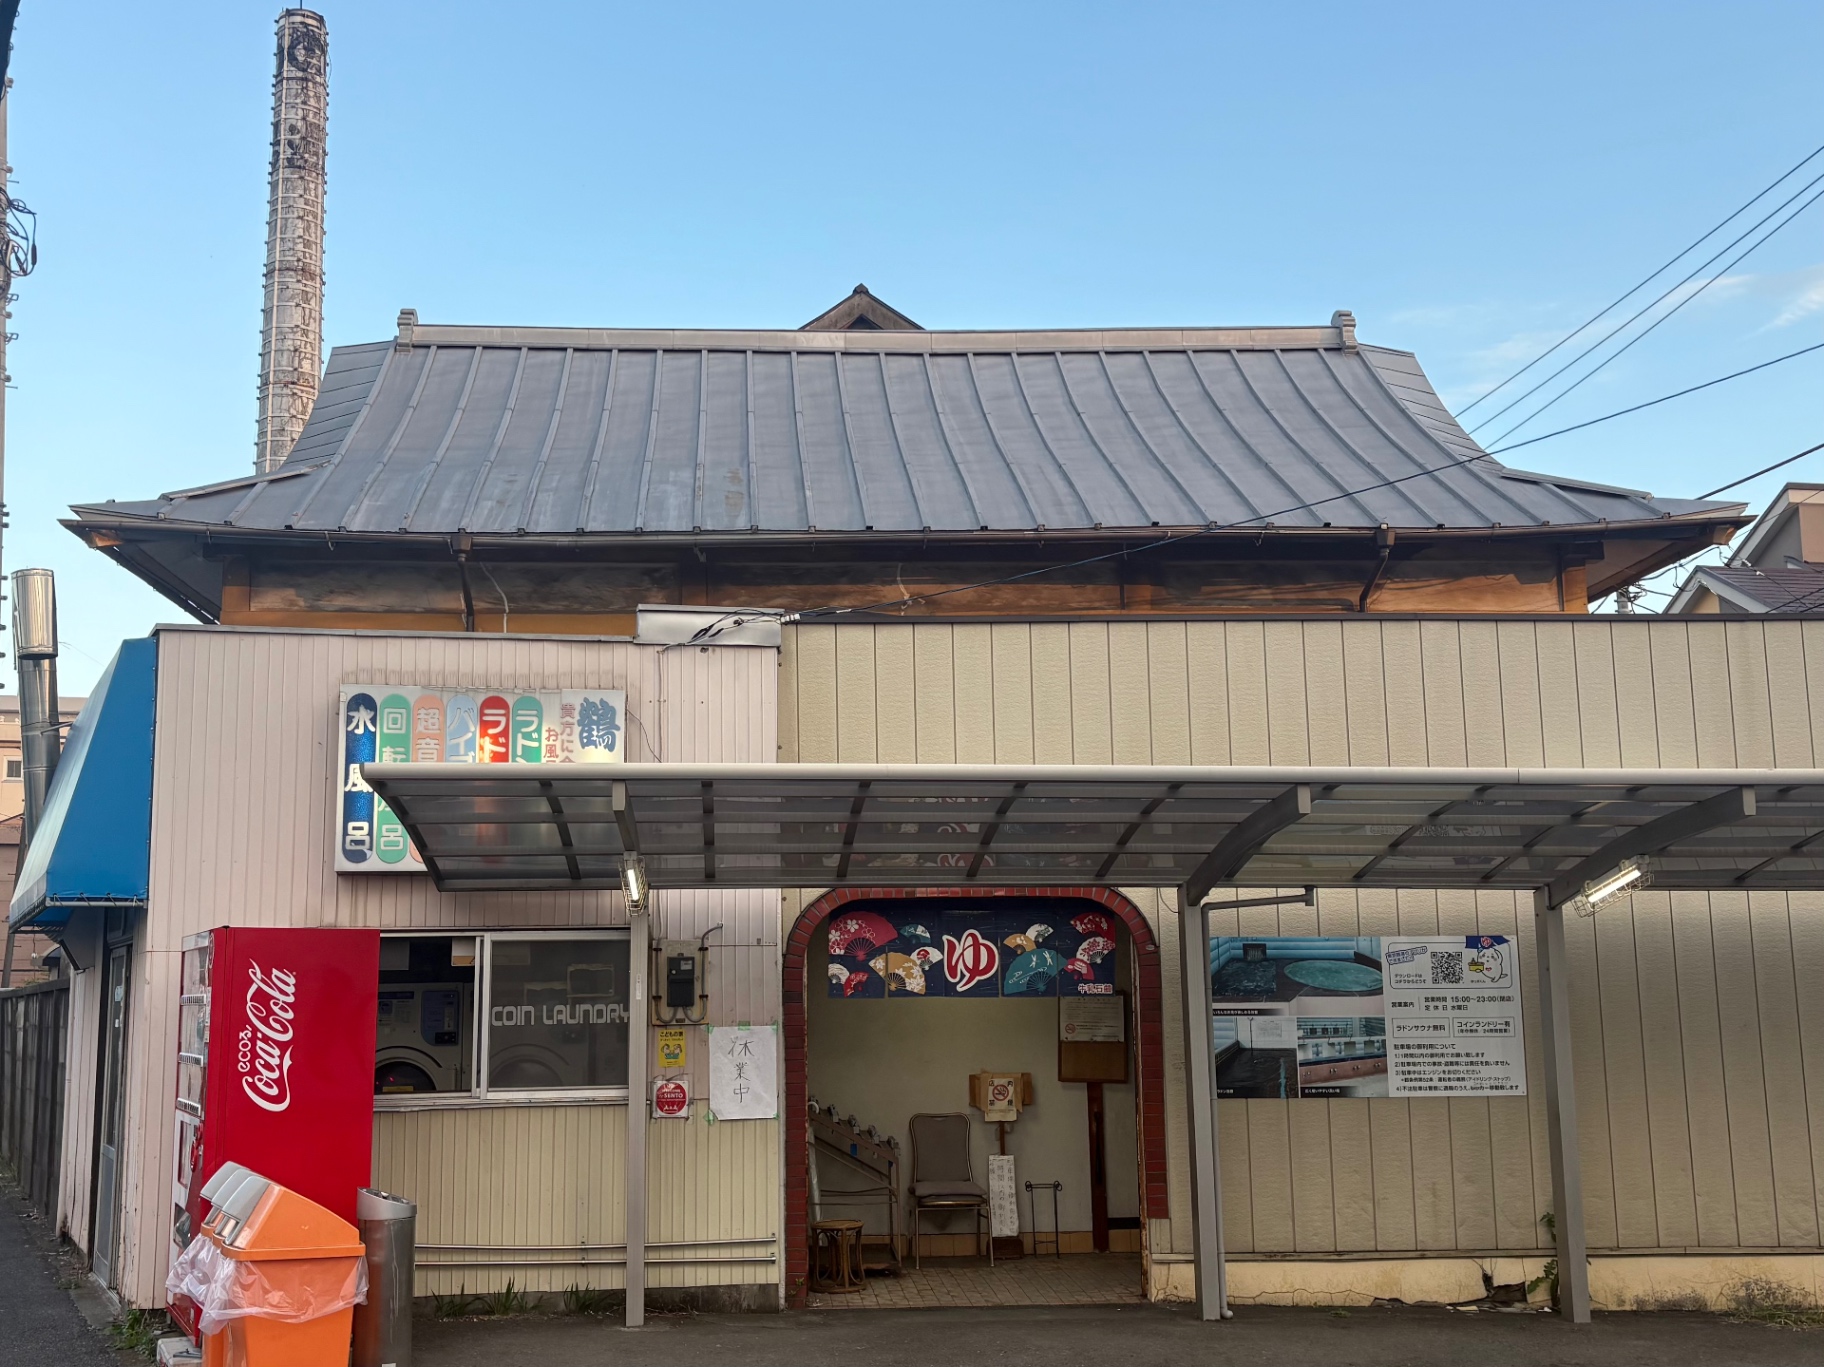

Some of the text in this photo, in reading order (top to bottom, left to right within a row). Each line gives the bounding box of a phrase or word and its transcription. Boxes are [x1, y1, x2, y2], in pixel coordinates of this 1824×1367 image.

[515, 709, 540, 763] ラド
[543, 727, 559, 763] お風
[344, 704, 376, 851] 水風呂
[378, 707, 408, 851] 回転呂
[942, 928, 999, 992] ゆ
[242, 957, 297, 1112] Coca-Cola
[491, 1003, 630, 1027] COIN LAUNDRY
[1395, 1024, 1446, 1032] ラドンサウナ無料
[1457, 1020, 1511, 1028] コインランドリー有
[727, 1036, 755, 1103] 休業中
[1393, 1043, 1457, 1051] 駐車場の御利用について
